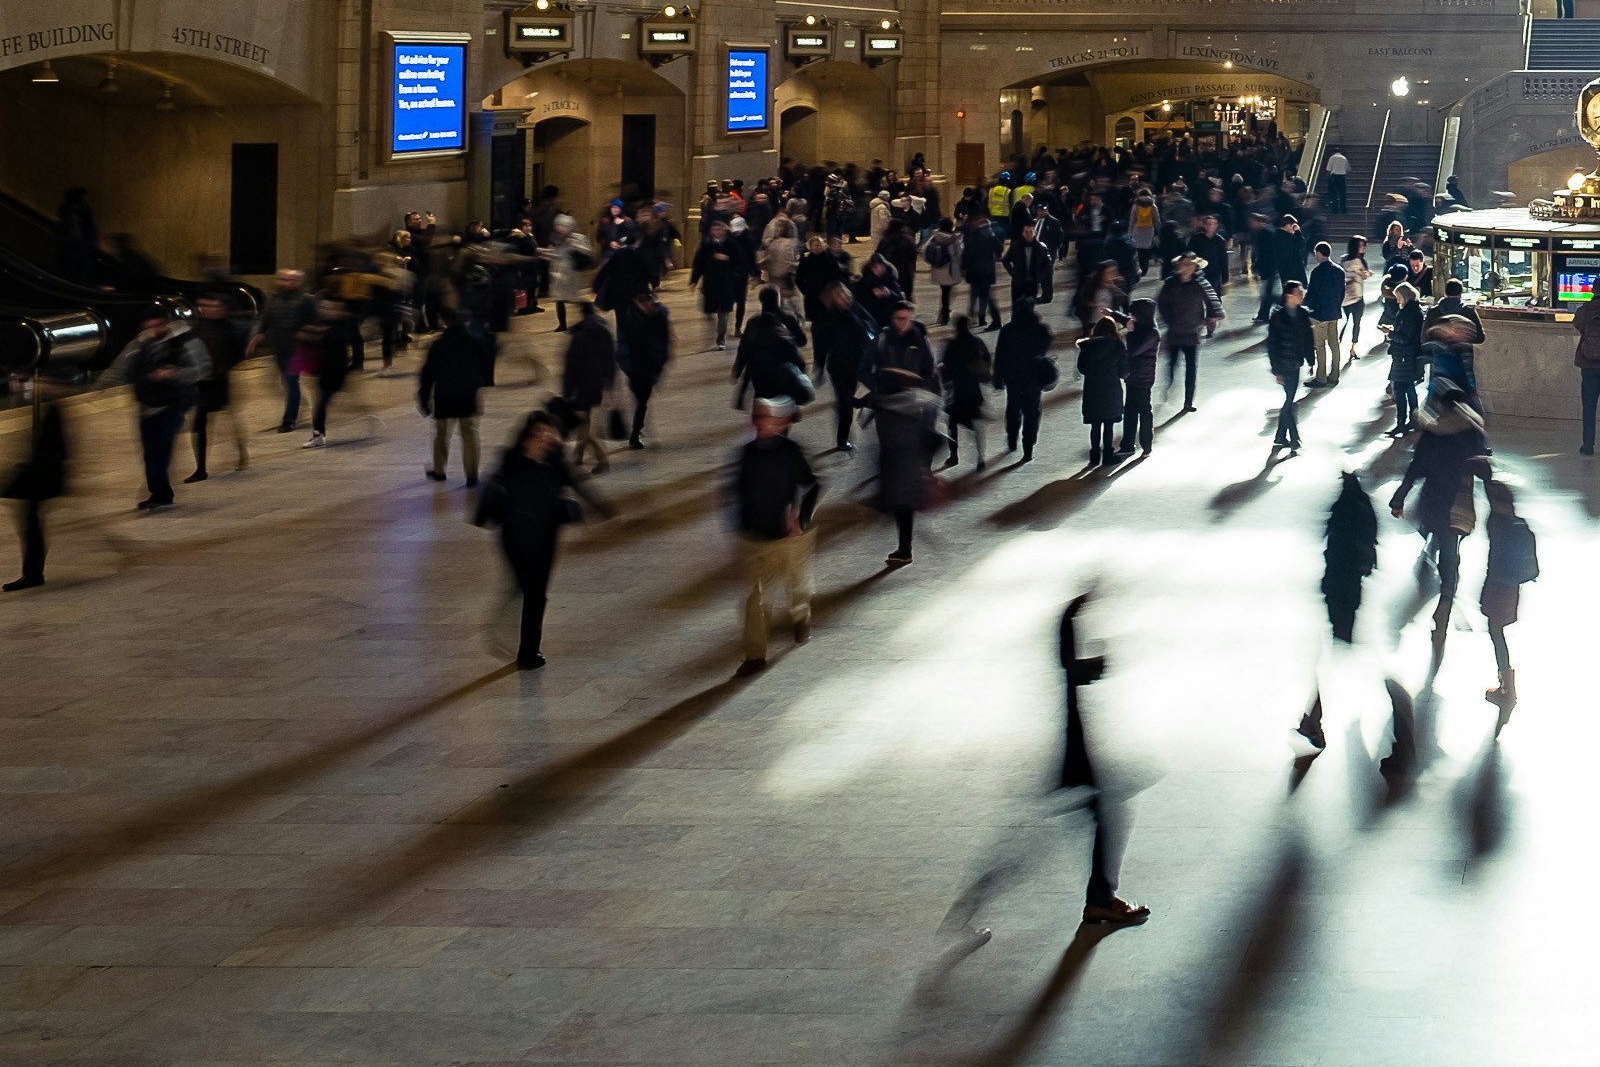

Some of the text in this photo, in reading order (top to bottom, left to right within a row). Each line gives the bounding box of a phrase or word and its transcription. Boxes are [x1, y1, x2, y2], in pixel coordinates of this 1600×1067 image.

[27, 23, 114, 51] BUILDING
[171, 27, 269, 64] 45TH STREET
[1049, 51, 1095, 68] TRACKS
[1097, 50, 1107, 60] 21
[1110, 47, 1128, 57] TO
[1183, 46, 1280, 71] LEXINGTON AVE
[1368, 48, 1435, 56] EAST BALCONY
[1129, 91, 1155, 103] 42ND
[1157, 86, 1191, 98] STREET
[1195, 83, 1236, 93] PASSAGE
[1245, 84, 1285, 94] SUBWAY
[551, 101, 571, 111] TRACK
[1528, 139, 1558, 152] TRACKS
